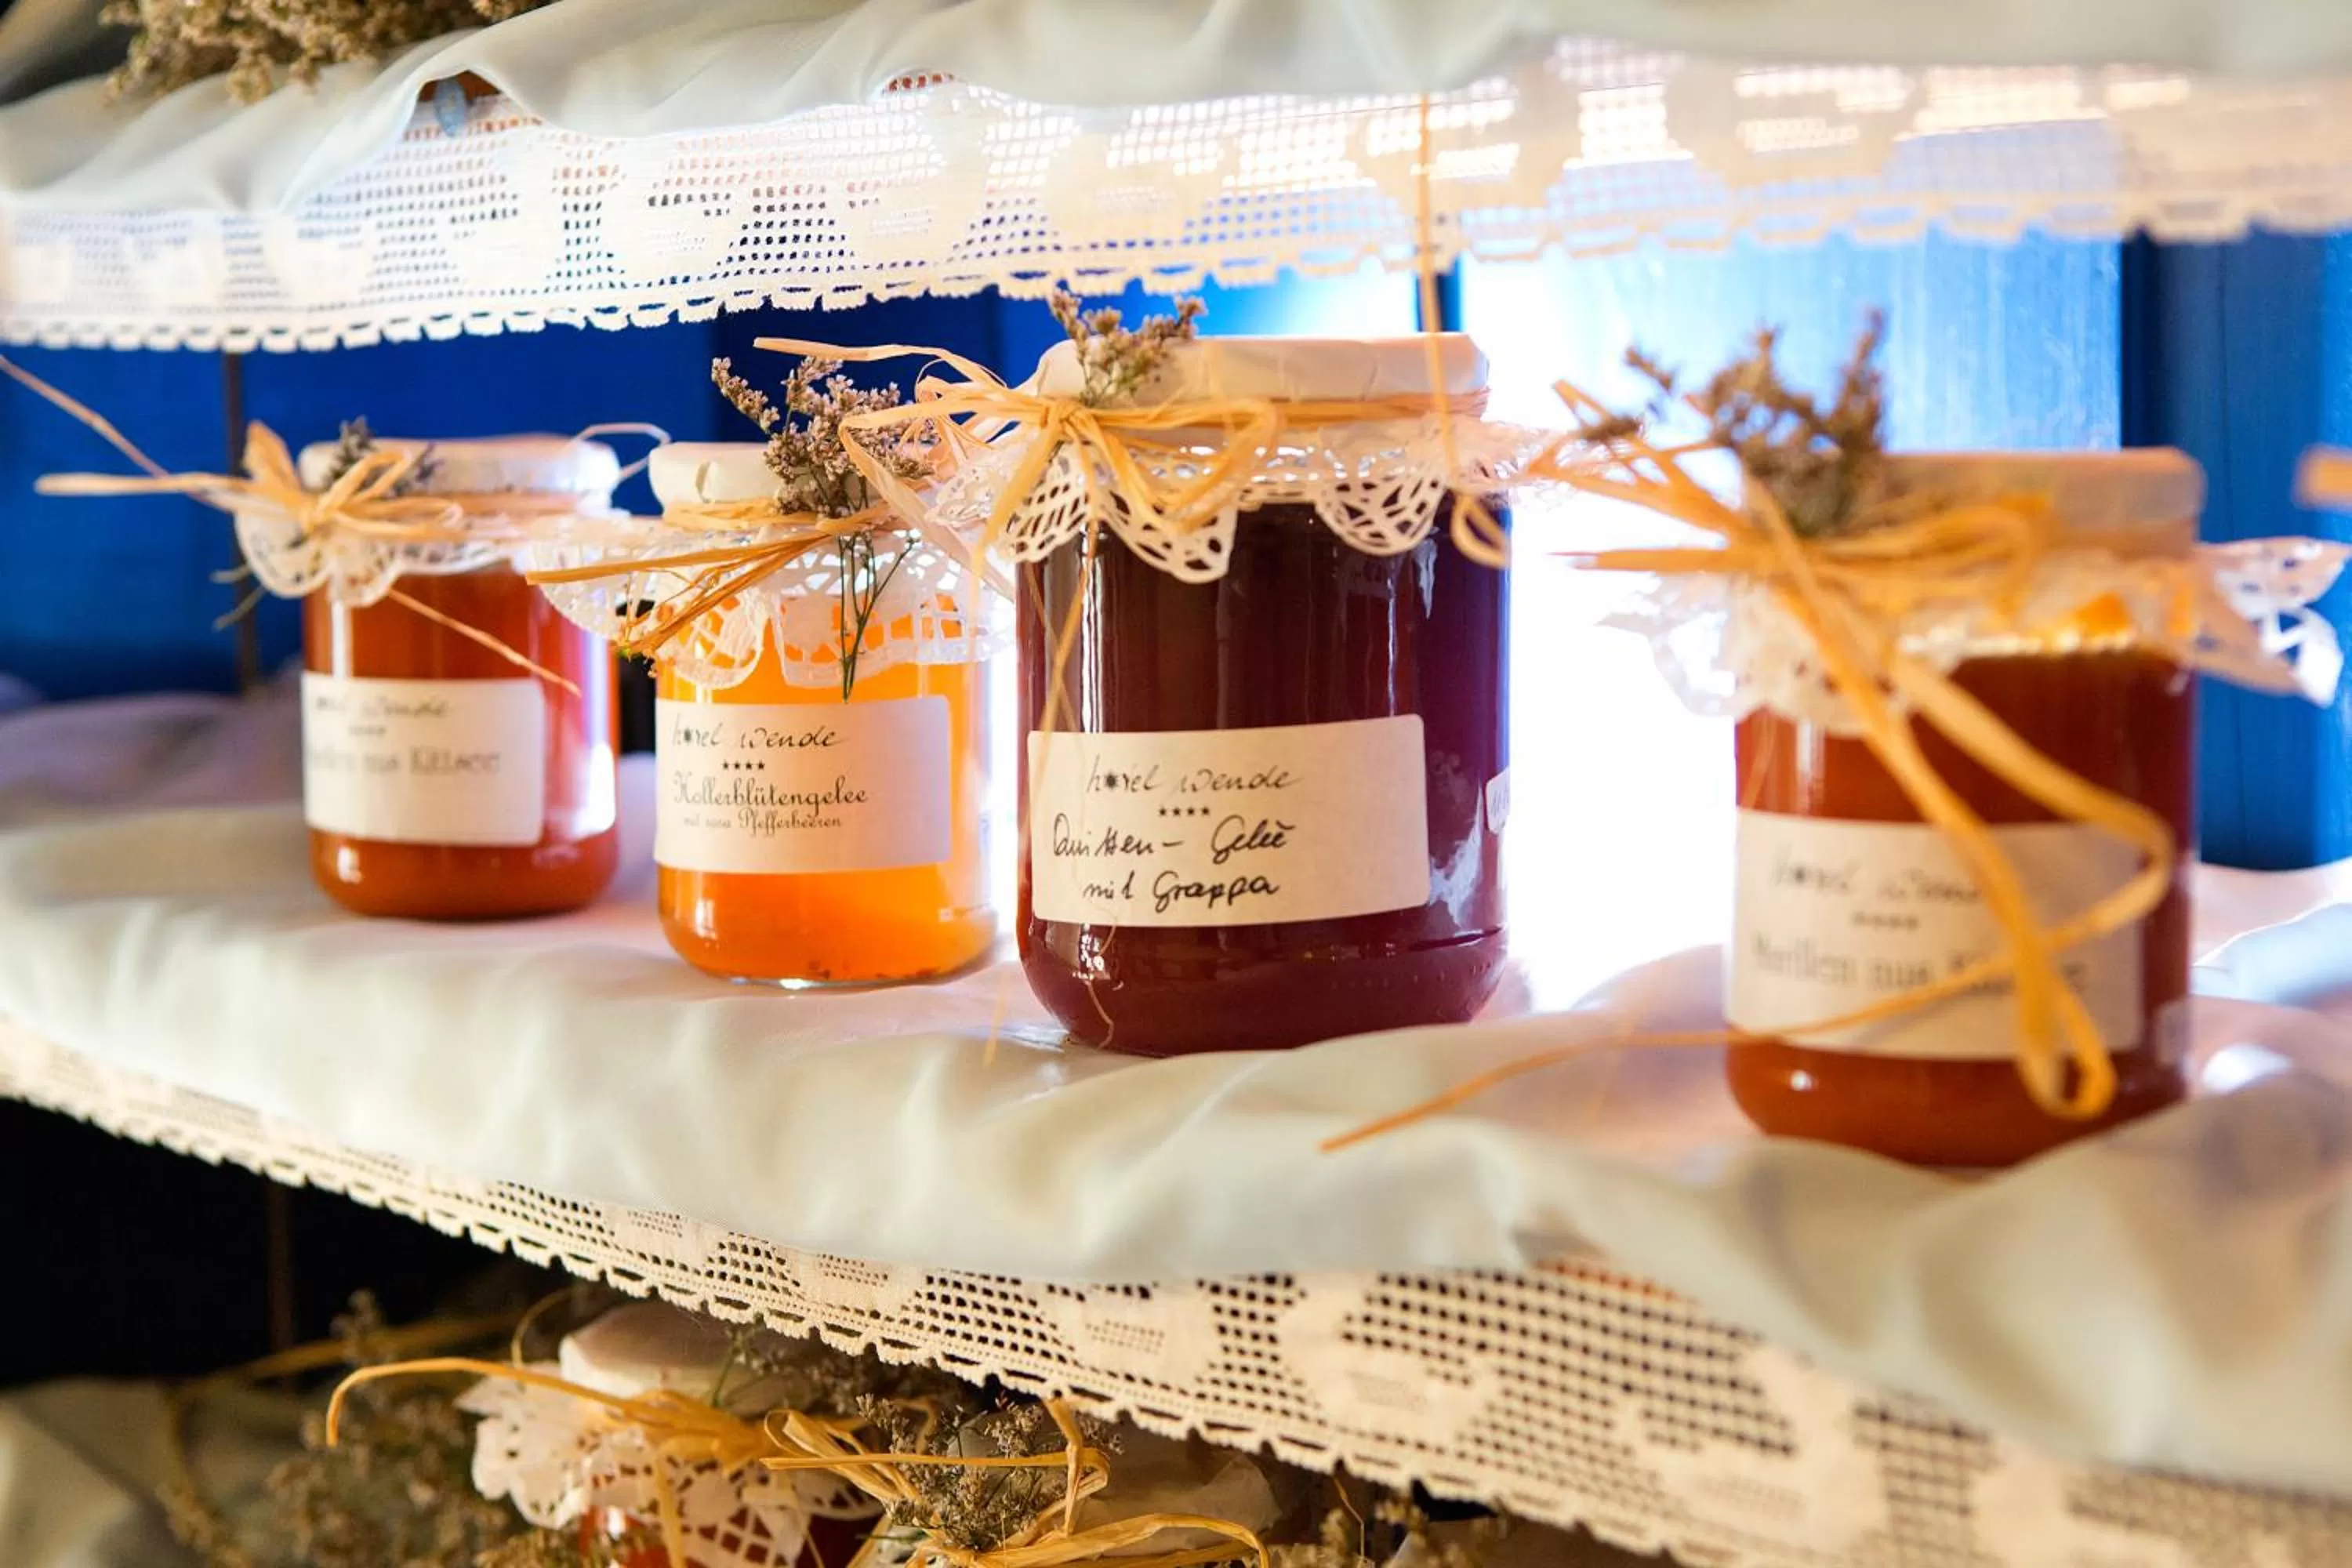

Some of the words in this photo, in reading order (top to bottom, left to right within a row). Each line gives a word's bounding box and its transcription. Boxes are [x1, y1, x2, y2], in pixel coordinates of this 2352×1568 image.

[738, 807, 843, 837] Pfefferbeeren
[1083, 869, 1135, 901] mit
[1153, 870, 1280, 913] Grappa
